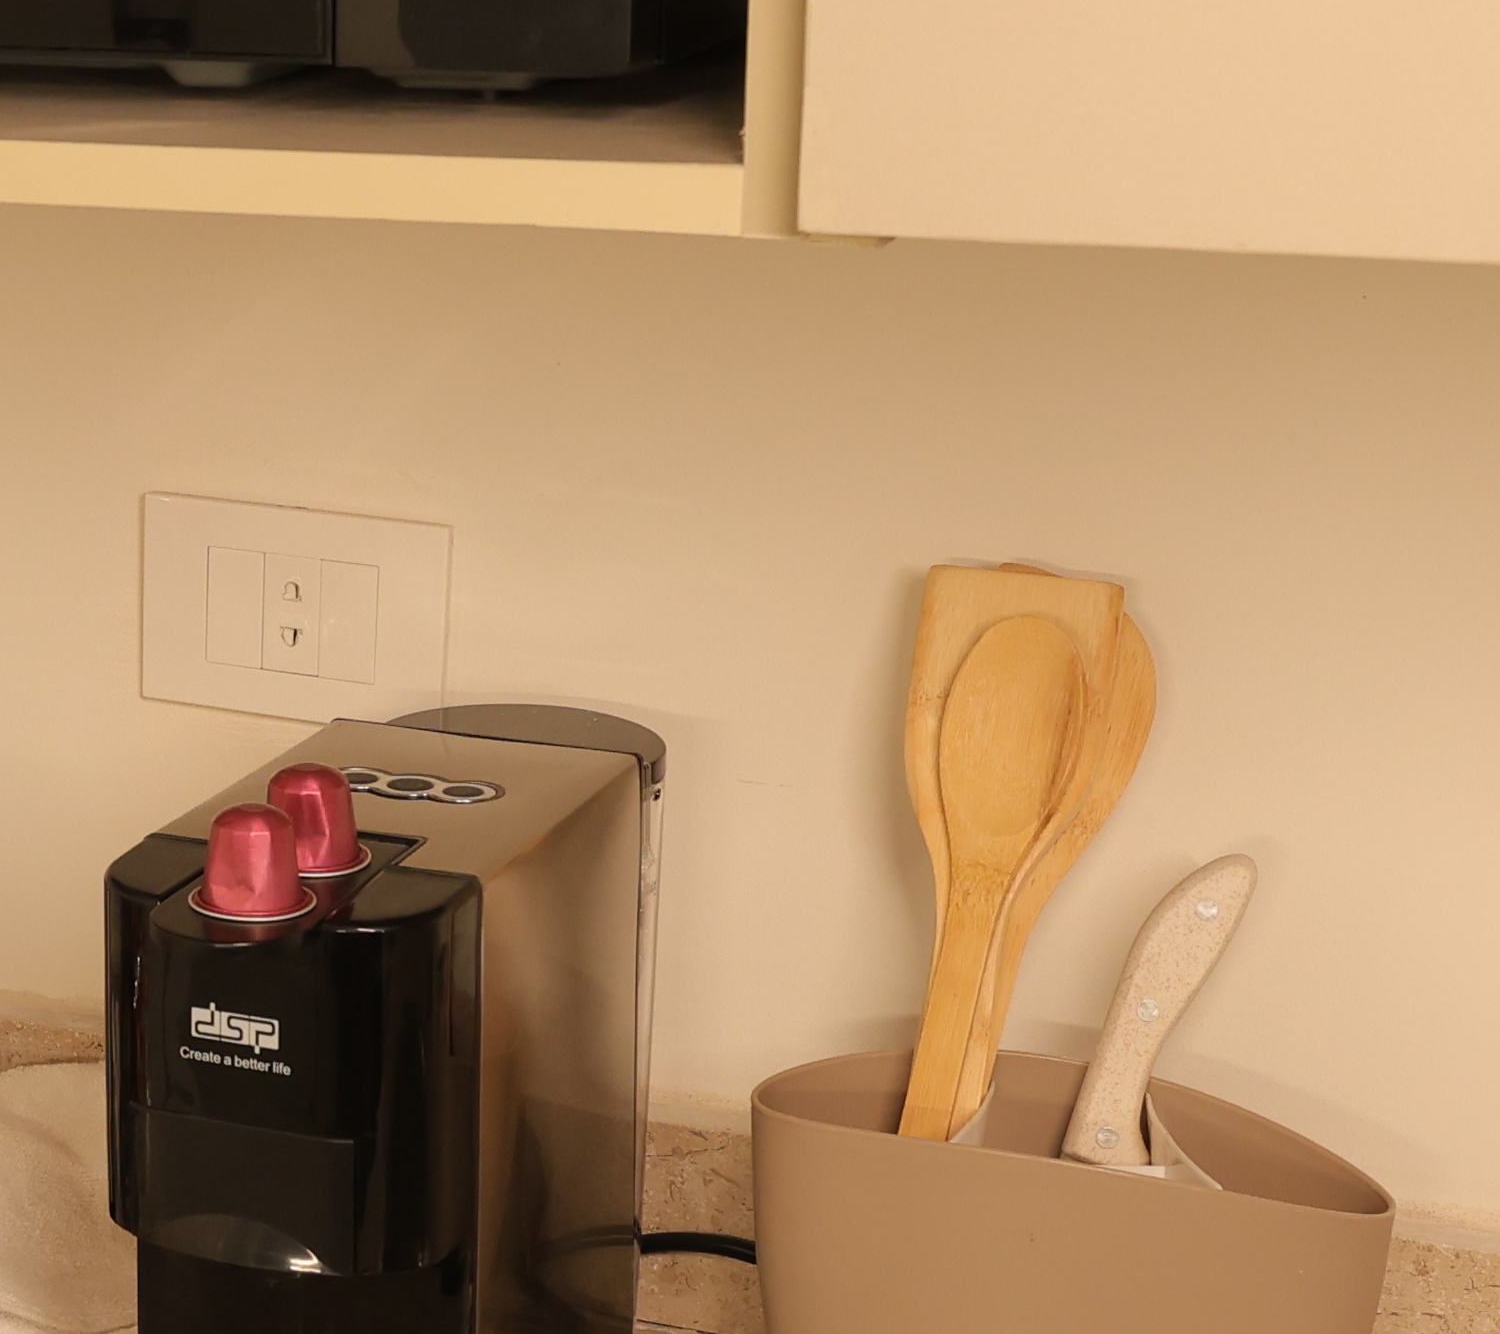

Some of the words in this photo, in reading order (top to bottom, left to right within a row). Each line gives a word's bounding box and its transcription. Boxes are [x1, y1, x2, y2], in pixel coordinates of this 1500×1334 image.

[190, 1001, 280, 1055] dsp
[179, 1045, 221, 1065] Create
[223, 1055, 232, 1066] a
[234, 1054, 271, 1073] better
[272, 1061, 292, 1077] life
